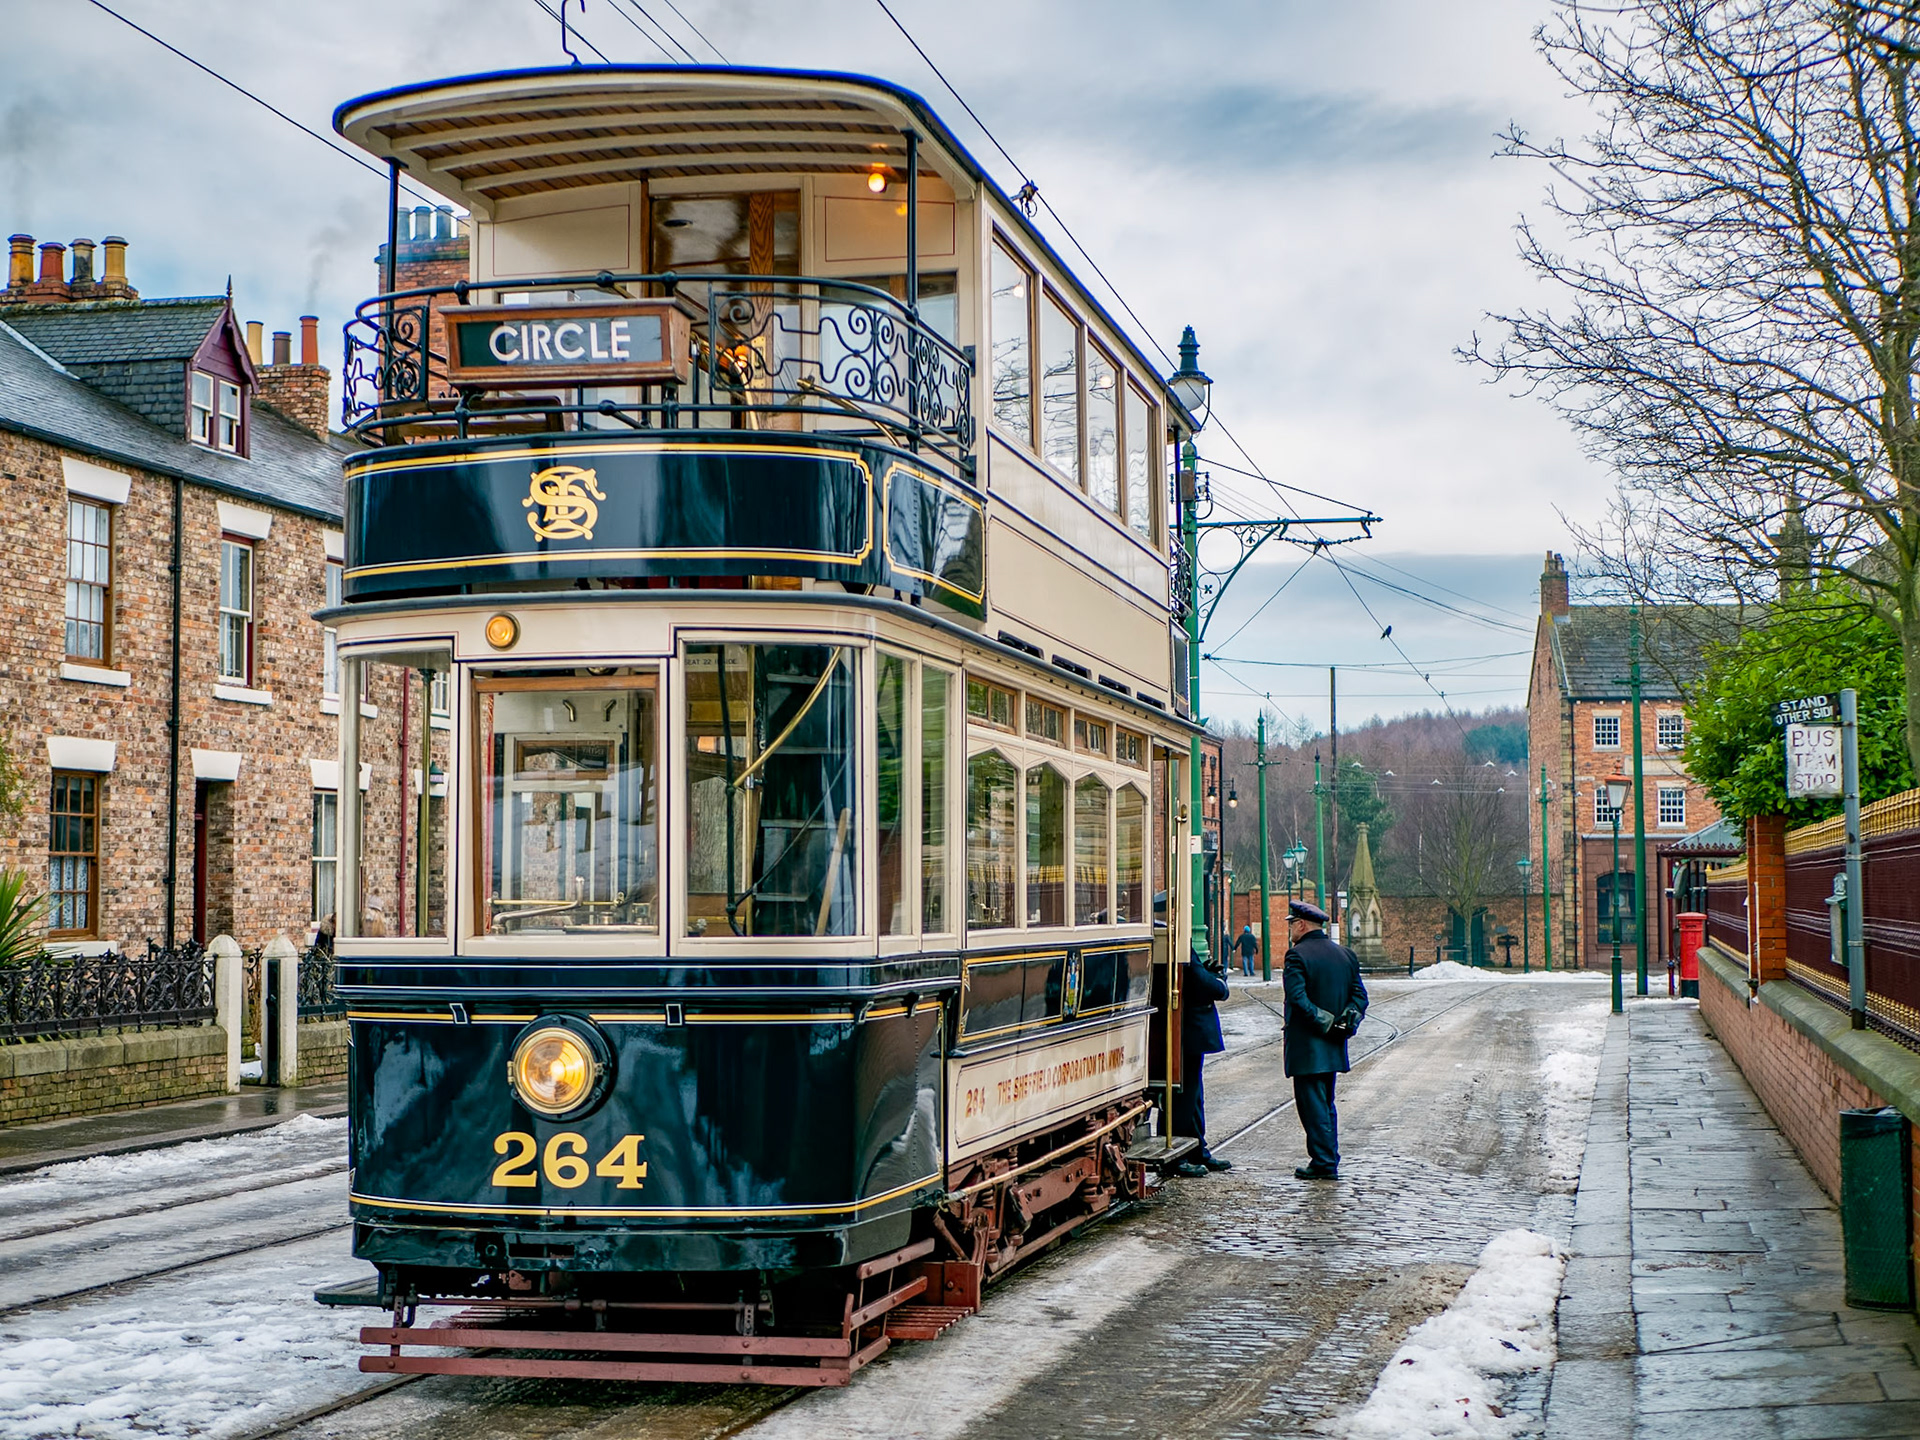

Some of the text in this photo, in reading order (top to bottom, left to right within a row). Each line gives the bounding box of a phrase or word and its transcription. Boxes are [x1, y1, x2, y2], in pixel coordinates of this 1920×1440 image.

[489, 321, 631, 362] CIRCLE
[1780, 696, 1827, 712] STAND
[1775, 710, 1810, 725] OTHER
[1792, 730, 1834, 747] BUS
[1793, 773, 1836, 790] STOP
[997, 1079, 1011, 1105] THE
[1013, 1067, 1051, 1102] SHEFFIELD
[1052, 1054, 1097, 1089] CORPORATION
[491, 1131, 648, 1189] 264
